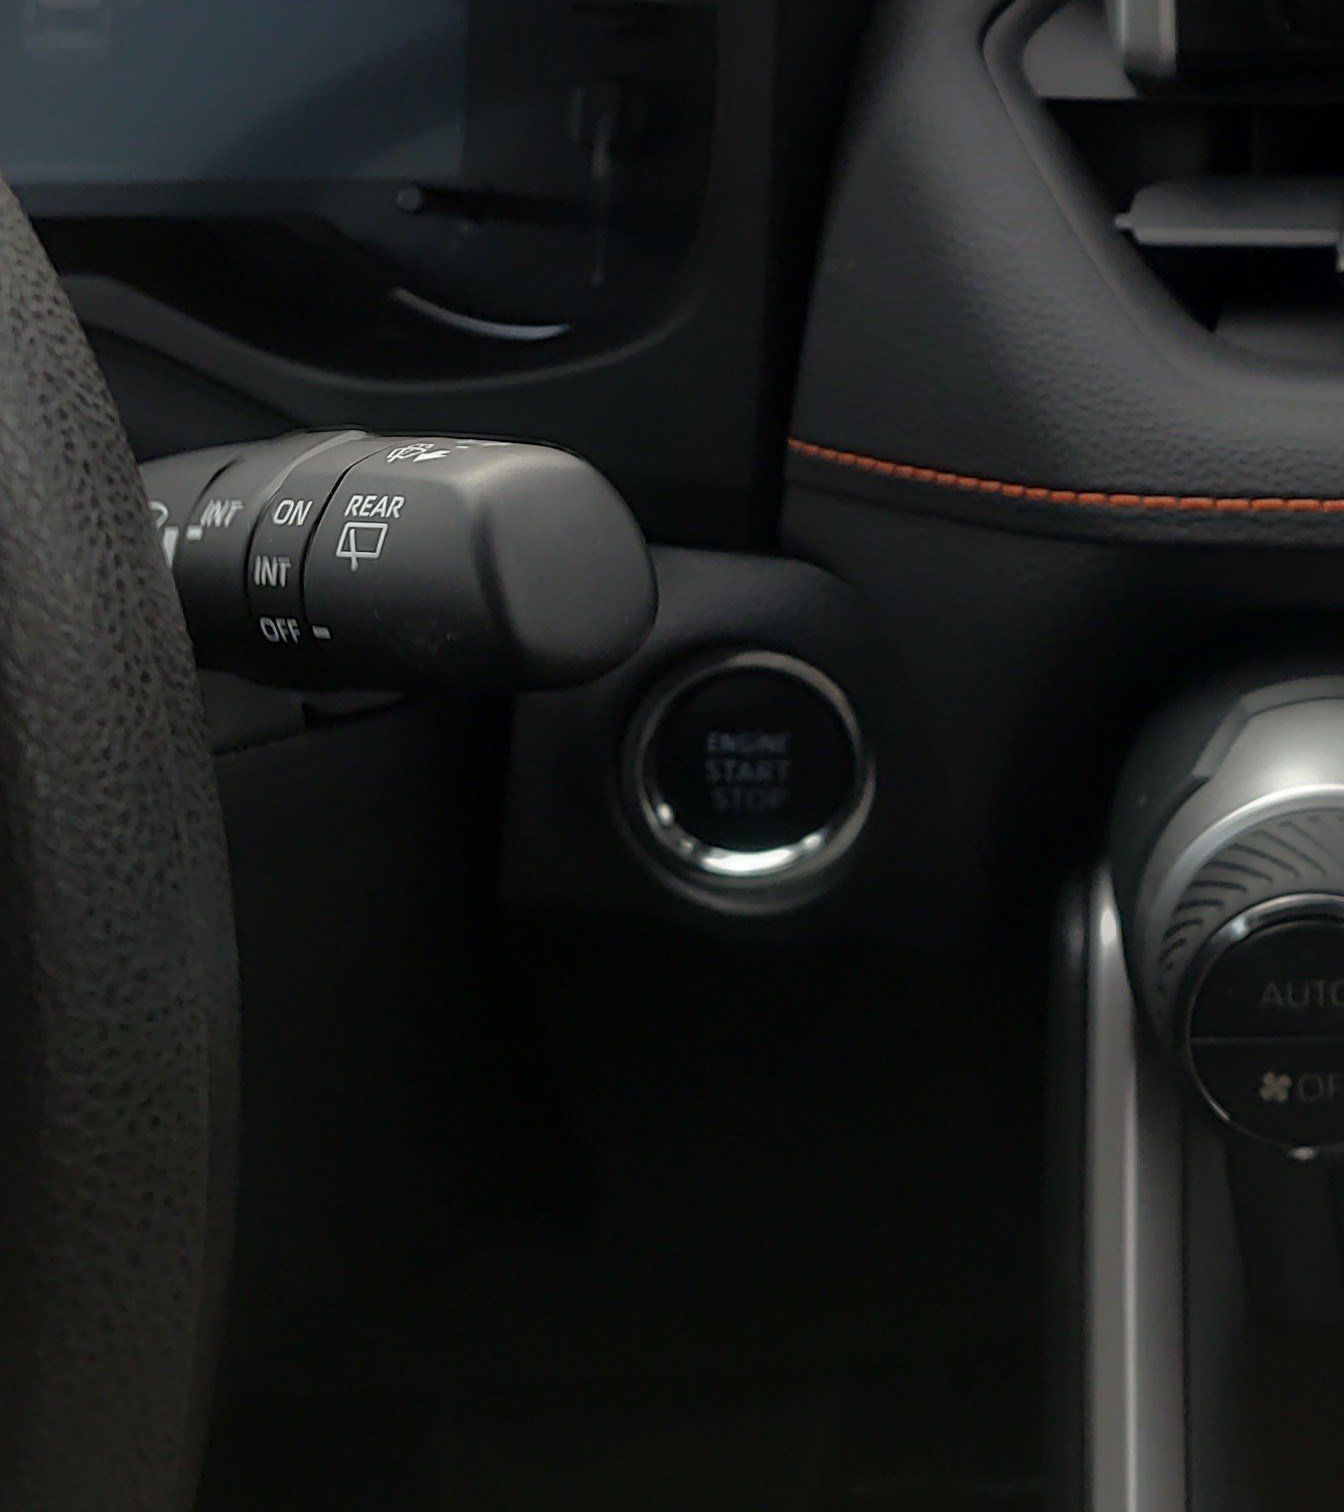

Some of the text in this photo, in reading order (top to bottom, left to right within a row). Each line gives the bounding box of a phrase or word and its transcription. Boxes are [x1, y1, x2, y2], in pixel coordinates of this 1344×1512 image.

[201, 499, 244, 527] INT
[272, 499, 312, 526] ON
[344, 495, 405, 519] REAR
[254, 555, 293, 588] INT
[259, 617, 300, 643] OFF
